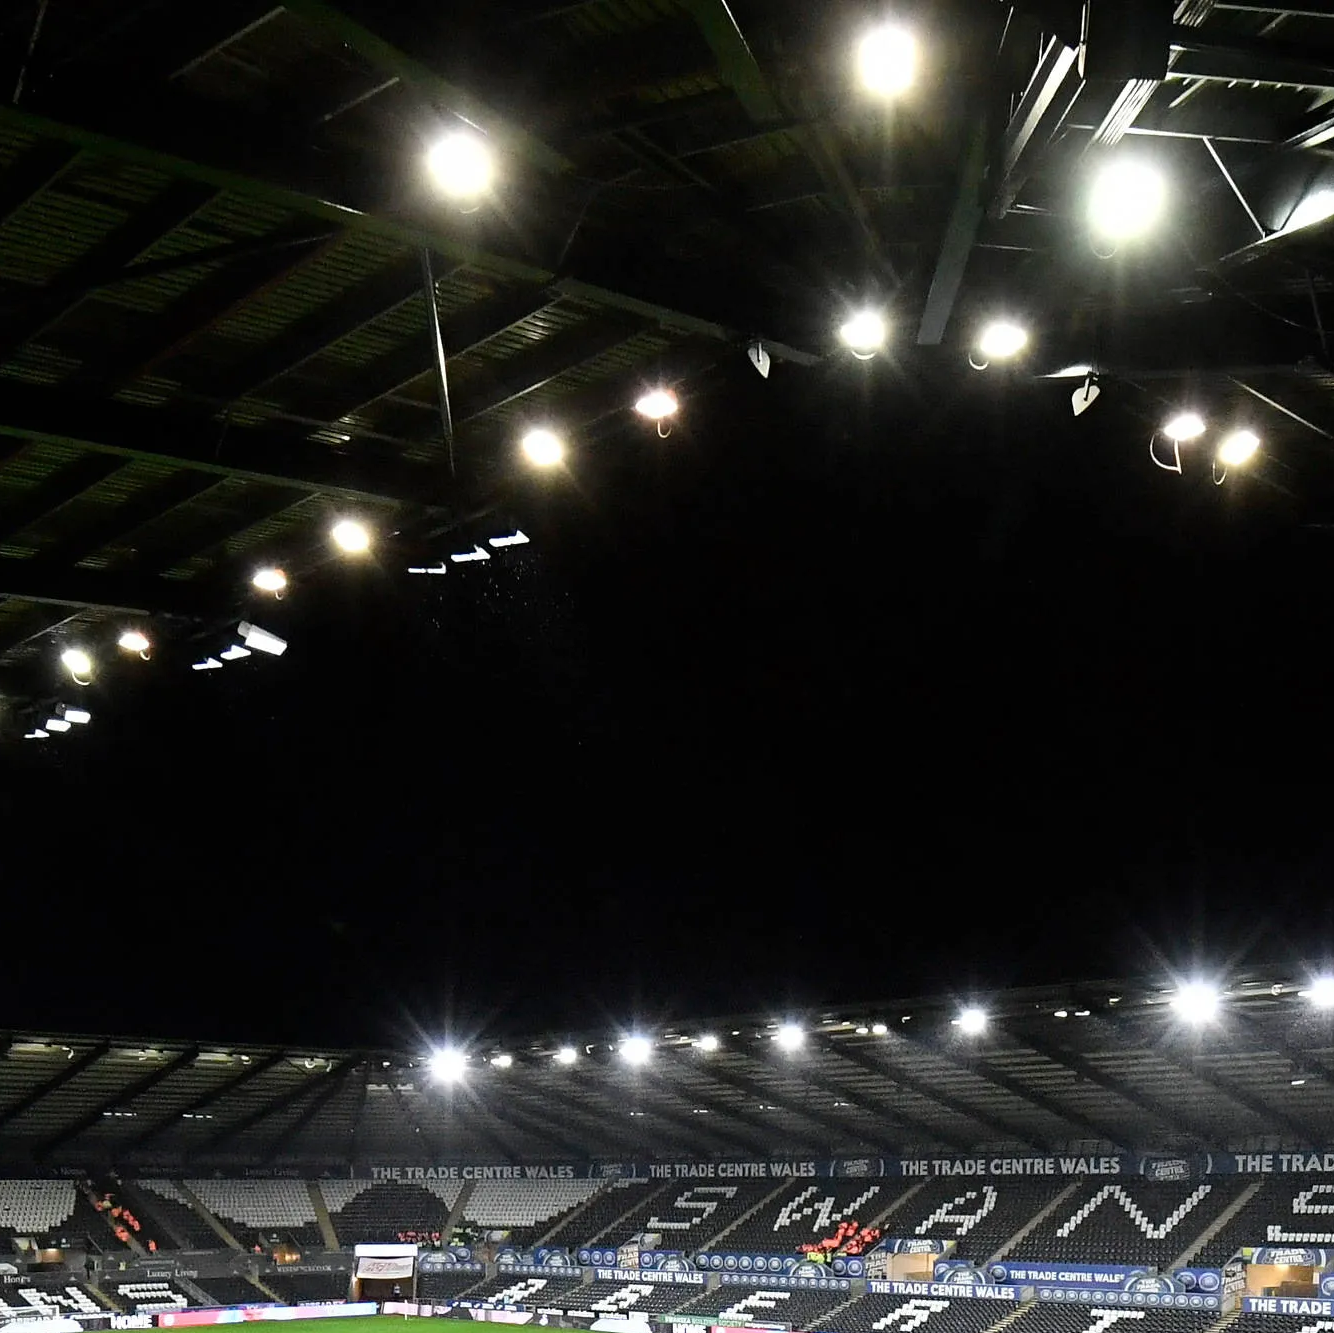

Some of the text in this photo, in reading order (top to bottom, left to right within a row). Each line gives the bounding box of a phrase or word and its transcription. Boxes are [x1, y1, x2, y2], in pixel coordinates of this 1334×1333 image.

[649, 1161, 816, 1177] THE TRADE CENTRE WALES
[900, 1157, 1121, 1176] THE TRADE CENTRE WALES
[1235, 1154, 1274, 1173] THE
[371, 1165, 575, 1179] THE TRADE CENTRE WALES
[598, 1268, 704, 1284] THE TRADE CENTRE WALES
[1010, 1270, 1026, 1279] THE
[1027, 1270, 1057, 1281] TRADE
[1058, 1272, 1092, 1282] CENTRE
[870, 1281, 1015, 1299] THE TRADE CENTRE WALES
[1249, 1298, 1277, 1313] THE
[1280, 1300, 1331, 1315] TRADE
[110, 1314, 153, 1329] HOME
